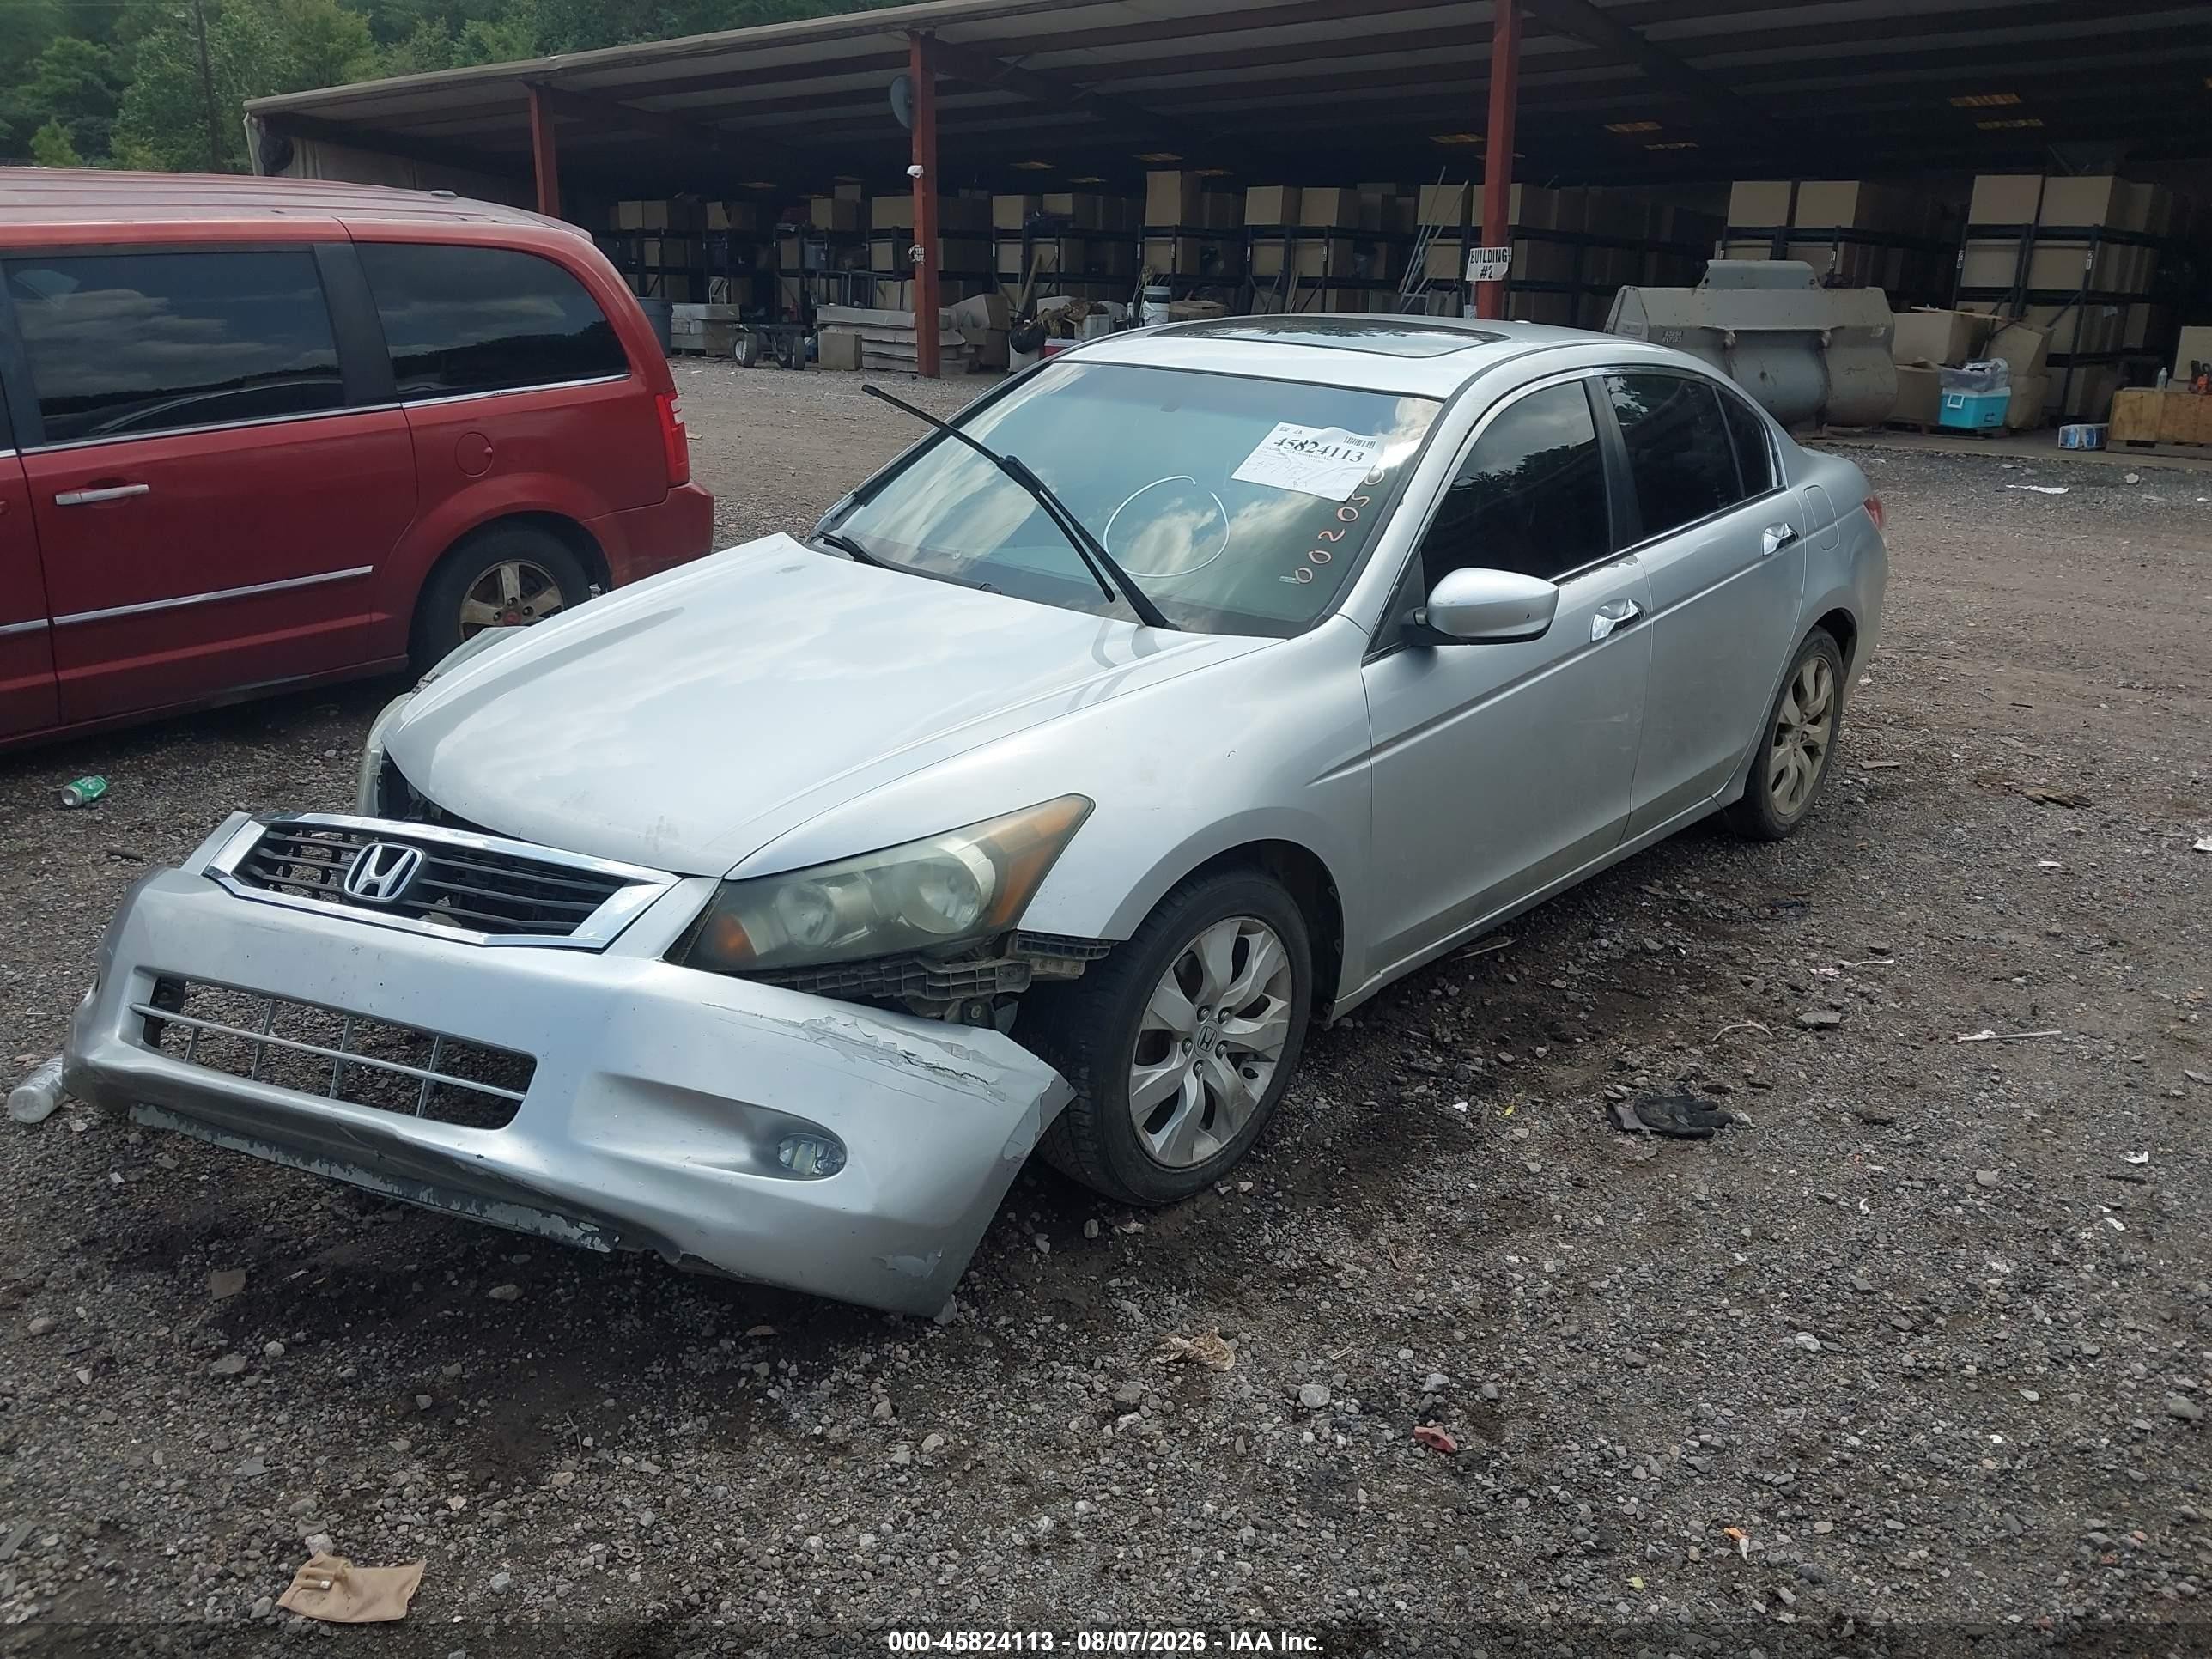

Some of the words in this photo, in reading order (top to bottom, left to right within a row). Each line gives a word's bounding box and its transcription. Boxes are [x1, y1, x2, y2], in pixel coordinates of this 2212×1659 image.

[1470, 248, 1508, 264] BUILDING
[1479, 264, 1493, 279] #2
[1273, 437, 1365, 463] 45824113
